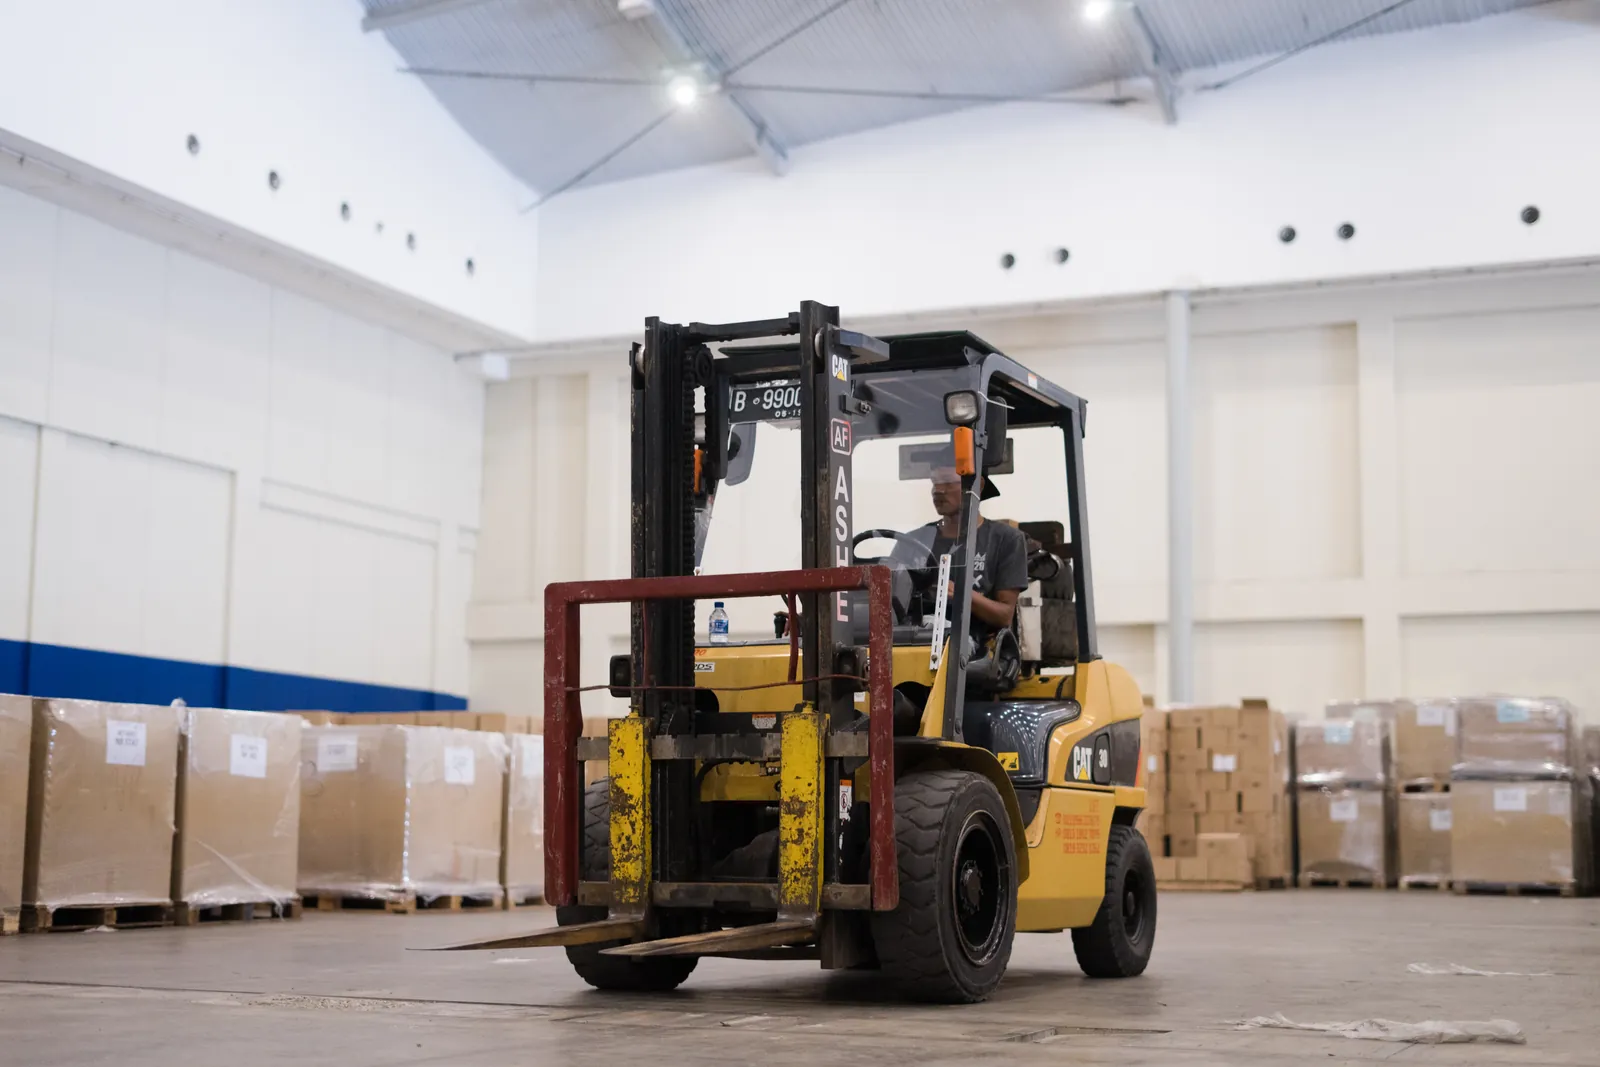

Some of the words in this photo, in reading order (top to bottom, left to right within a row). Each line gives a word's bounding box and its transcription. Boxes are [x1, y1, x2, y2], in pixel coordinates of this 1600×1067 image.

[832, 354, 848, 381] CAT
[734, 390, 747, 412] B
[834, 425, 849, 448] AF
[1073, 745, 1092, 780] CAT
[1098, 748, 1108, 768] 30
